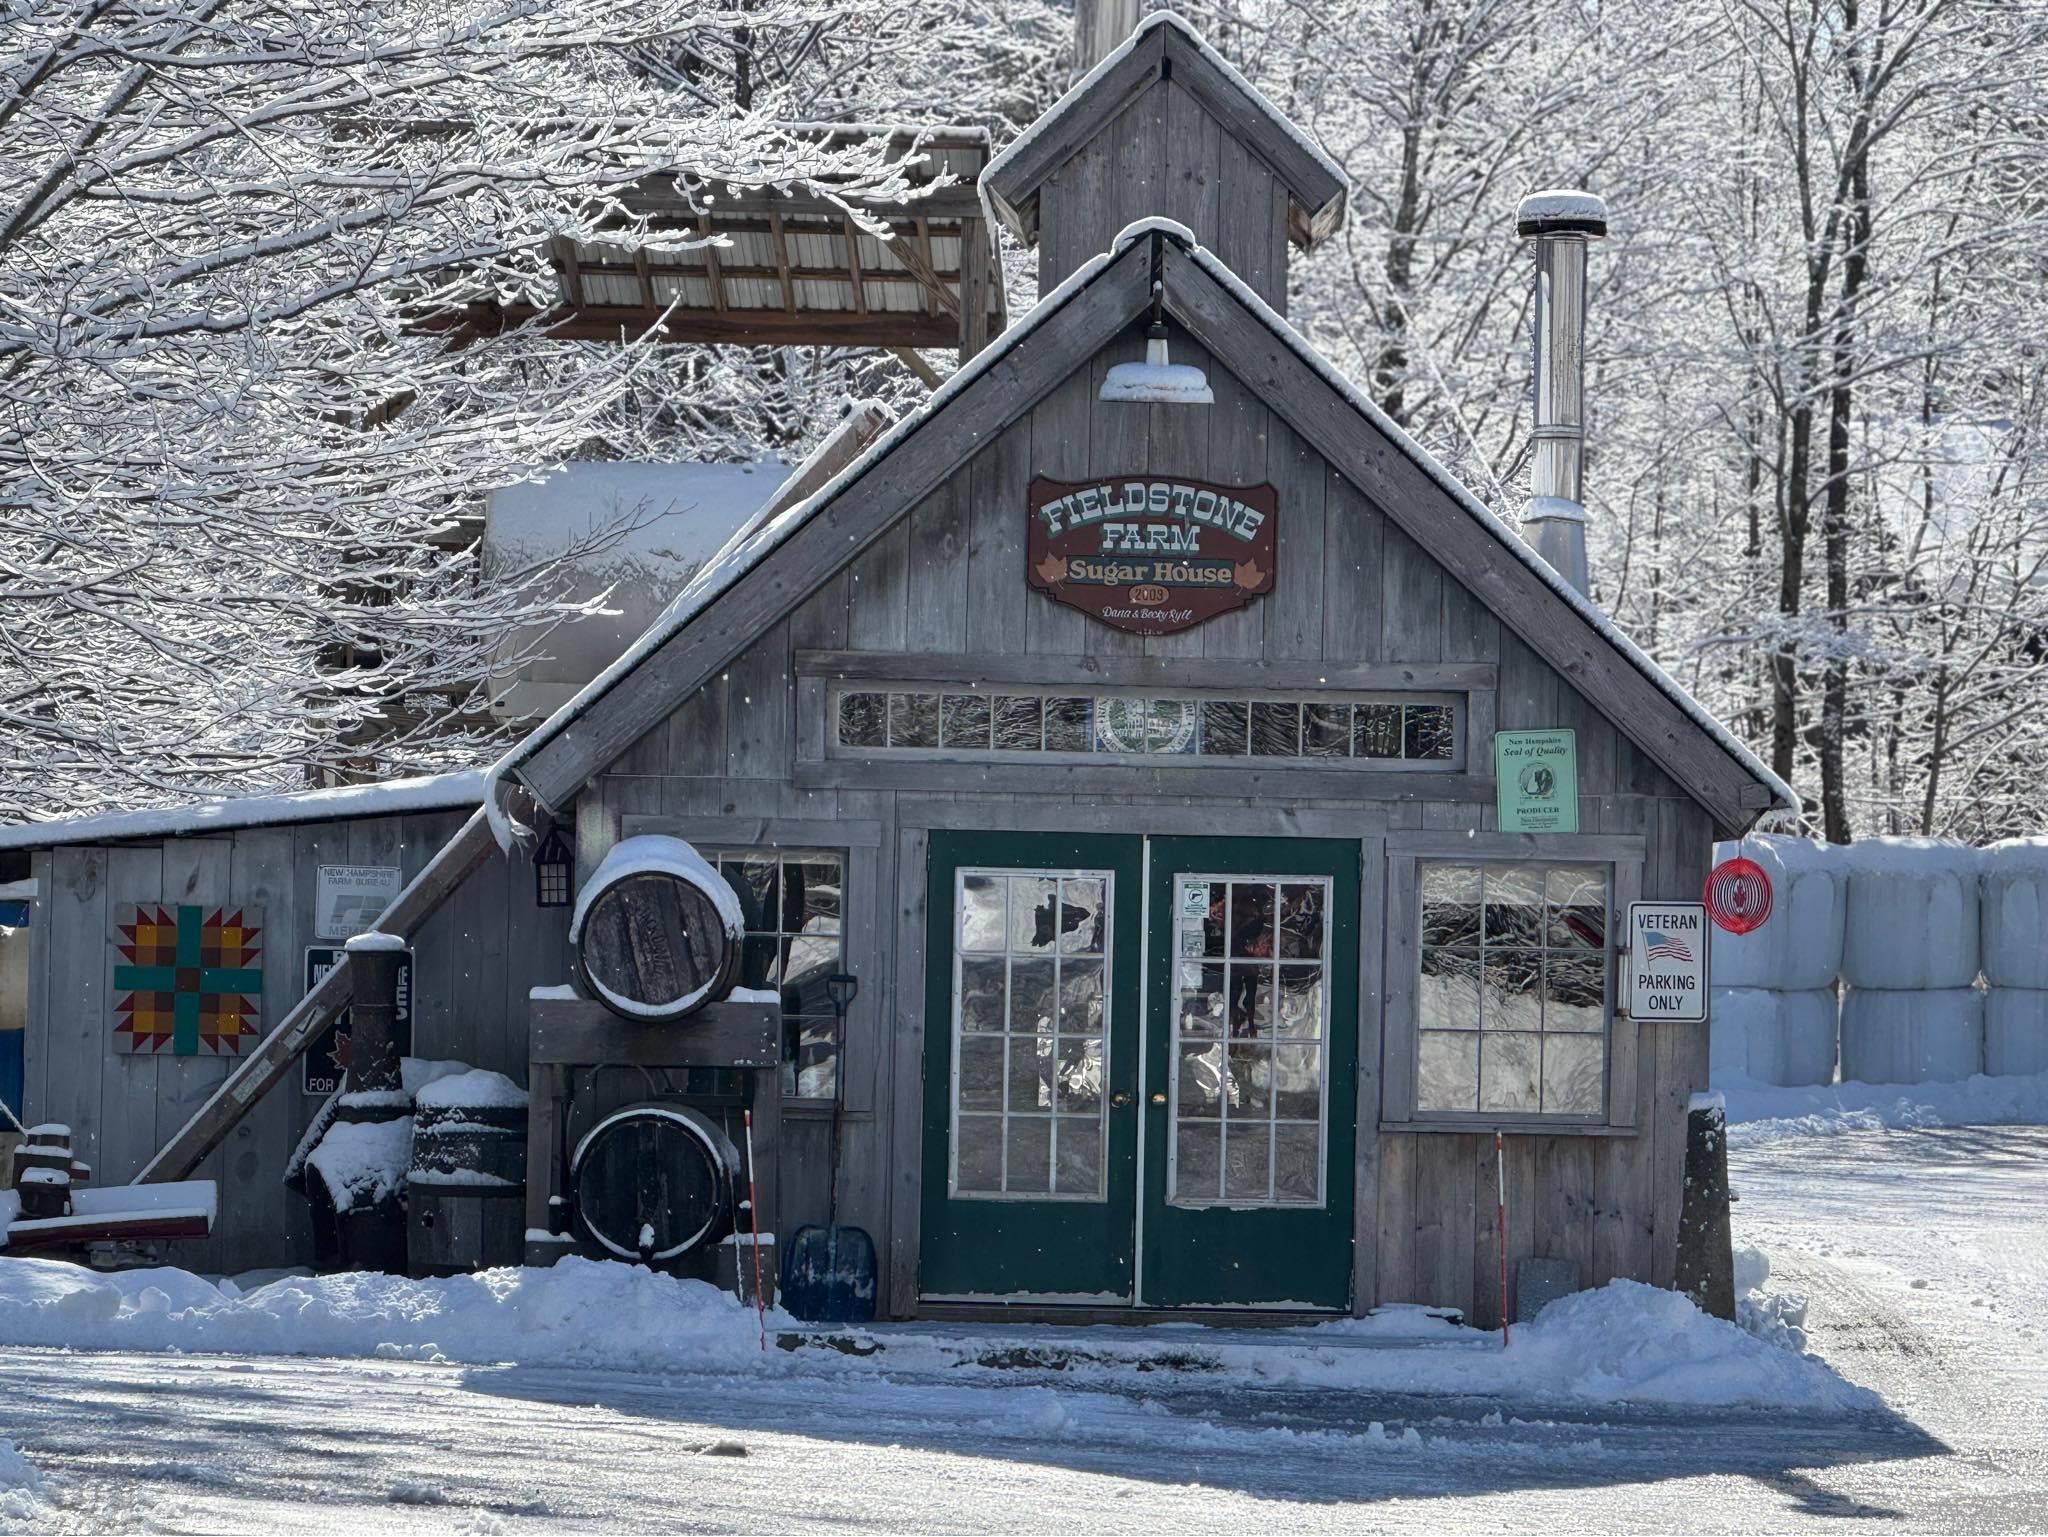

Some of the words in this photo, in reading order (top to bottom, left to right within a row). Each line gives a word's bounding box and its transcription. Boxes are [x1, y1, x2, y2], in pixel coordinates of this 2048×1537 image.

[1039, 482, 1265, 541] FIELDSTONE
[1101, 522, 1201, 552] FARM
[1069, 560, 1149, 585] Sugar
[1153, 562, 1232, 583] House
[1102, 606, 1131, 618] Dana
[1140, 608, 1169, 622] Becky
[1168, 609, 1193, 623] Ryll
[1503, 747, 1523, 757] Seal
[1524, 747, 1535, 757] of
[1536, 746, 1568, 757] Quality
[324, 868, 344, 877] NEW
[346, 869, 396, 879] HAMPSHIRE
[328, 877, 351, 886] FARM
[355, 878, 391, 888] BUREAU
[1638, 914, 1698, 930] VETERAN
[1638, 974, 1696, 991] PARKING
[1648, 995, 1684, 1011] ONLY
[309, 1078, 334, 1092] FOR
